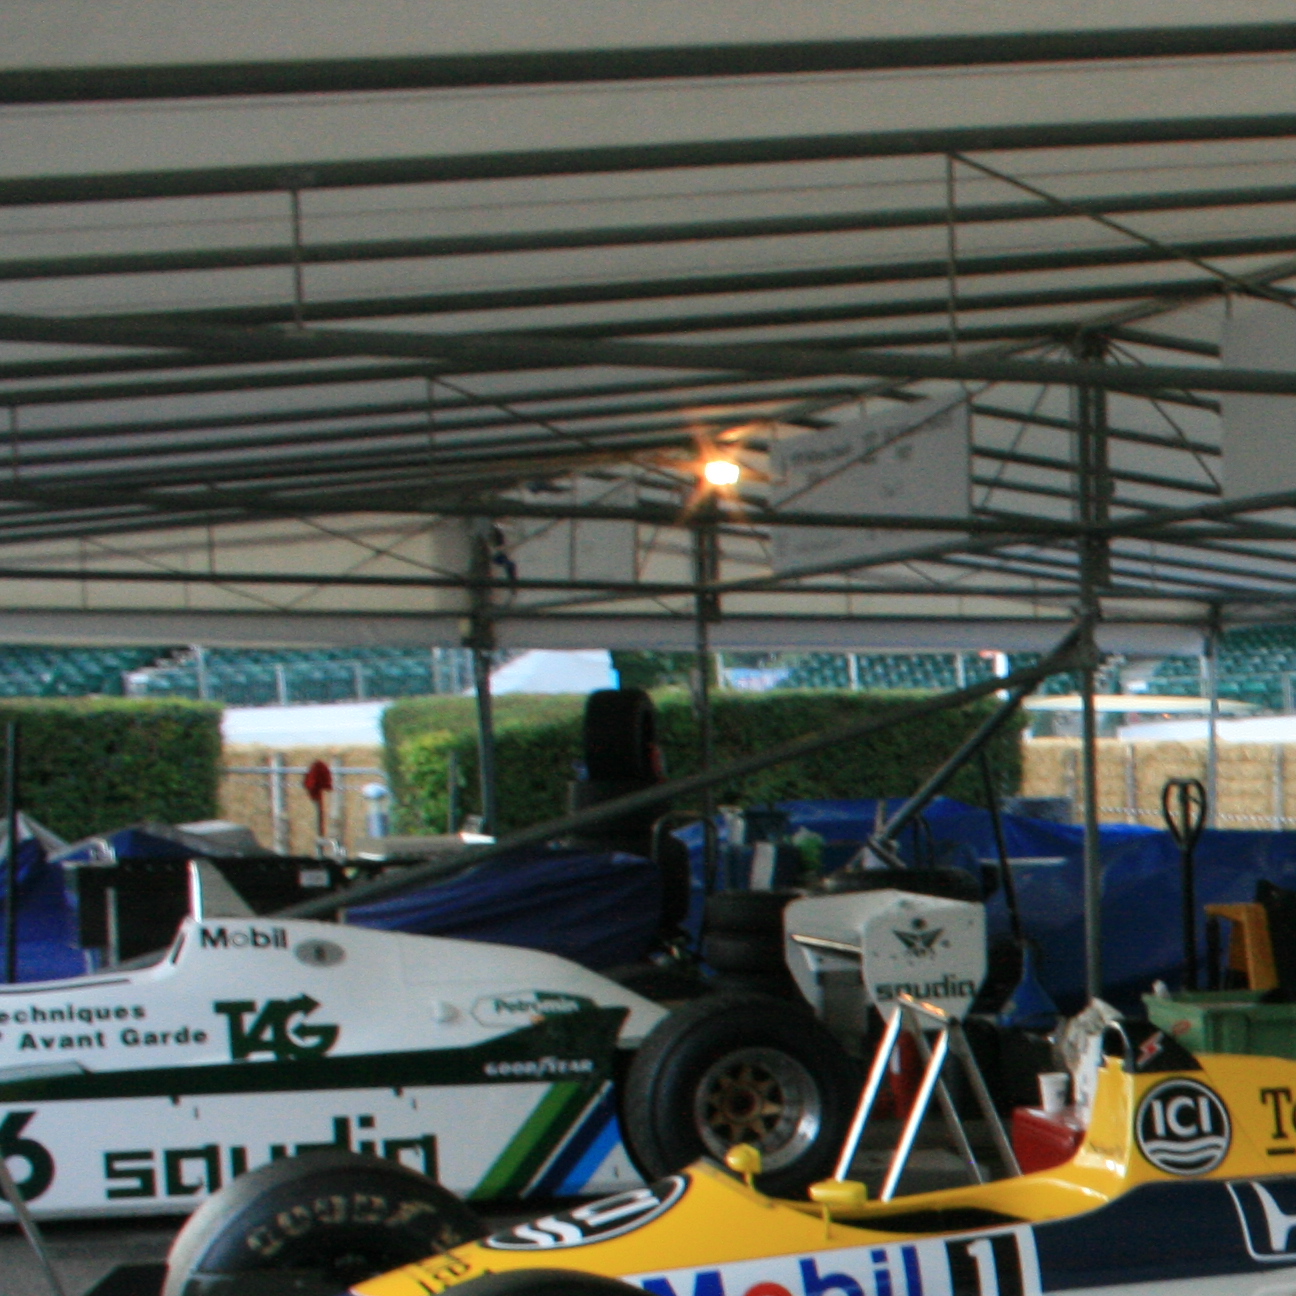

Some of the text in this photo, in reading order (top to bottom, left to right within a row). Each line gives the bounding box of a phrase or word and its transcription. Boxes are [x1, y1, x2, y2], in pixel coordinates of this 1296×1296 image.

[199, 927, 288, 950] Mobil
[19, 1026, 209, 1051] Avant Garde
[213, 993, 341, 1061] TAG
[1153, 1098, 1214, 1138] ICI
